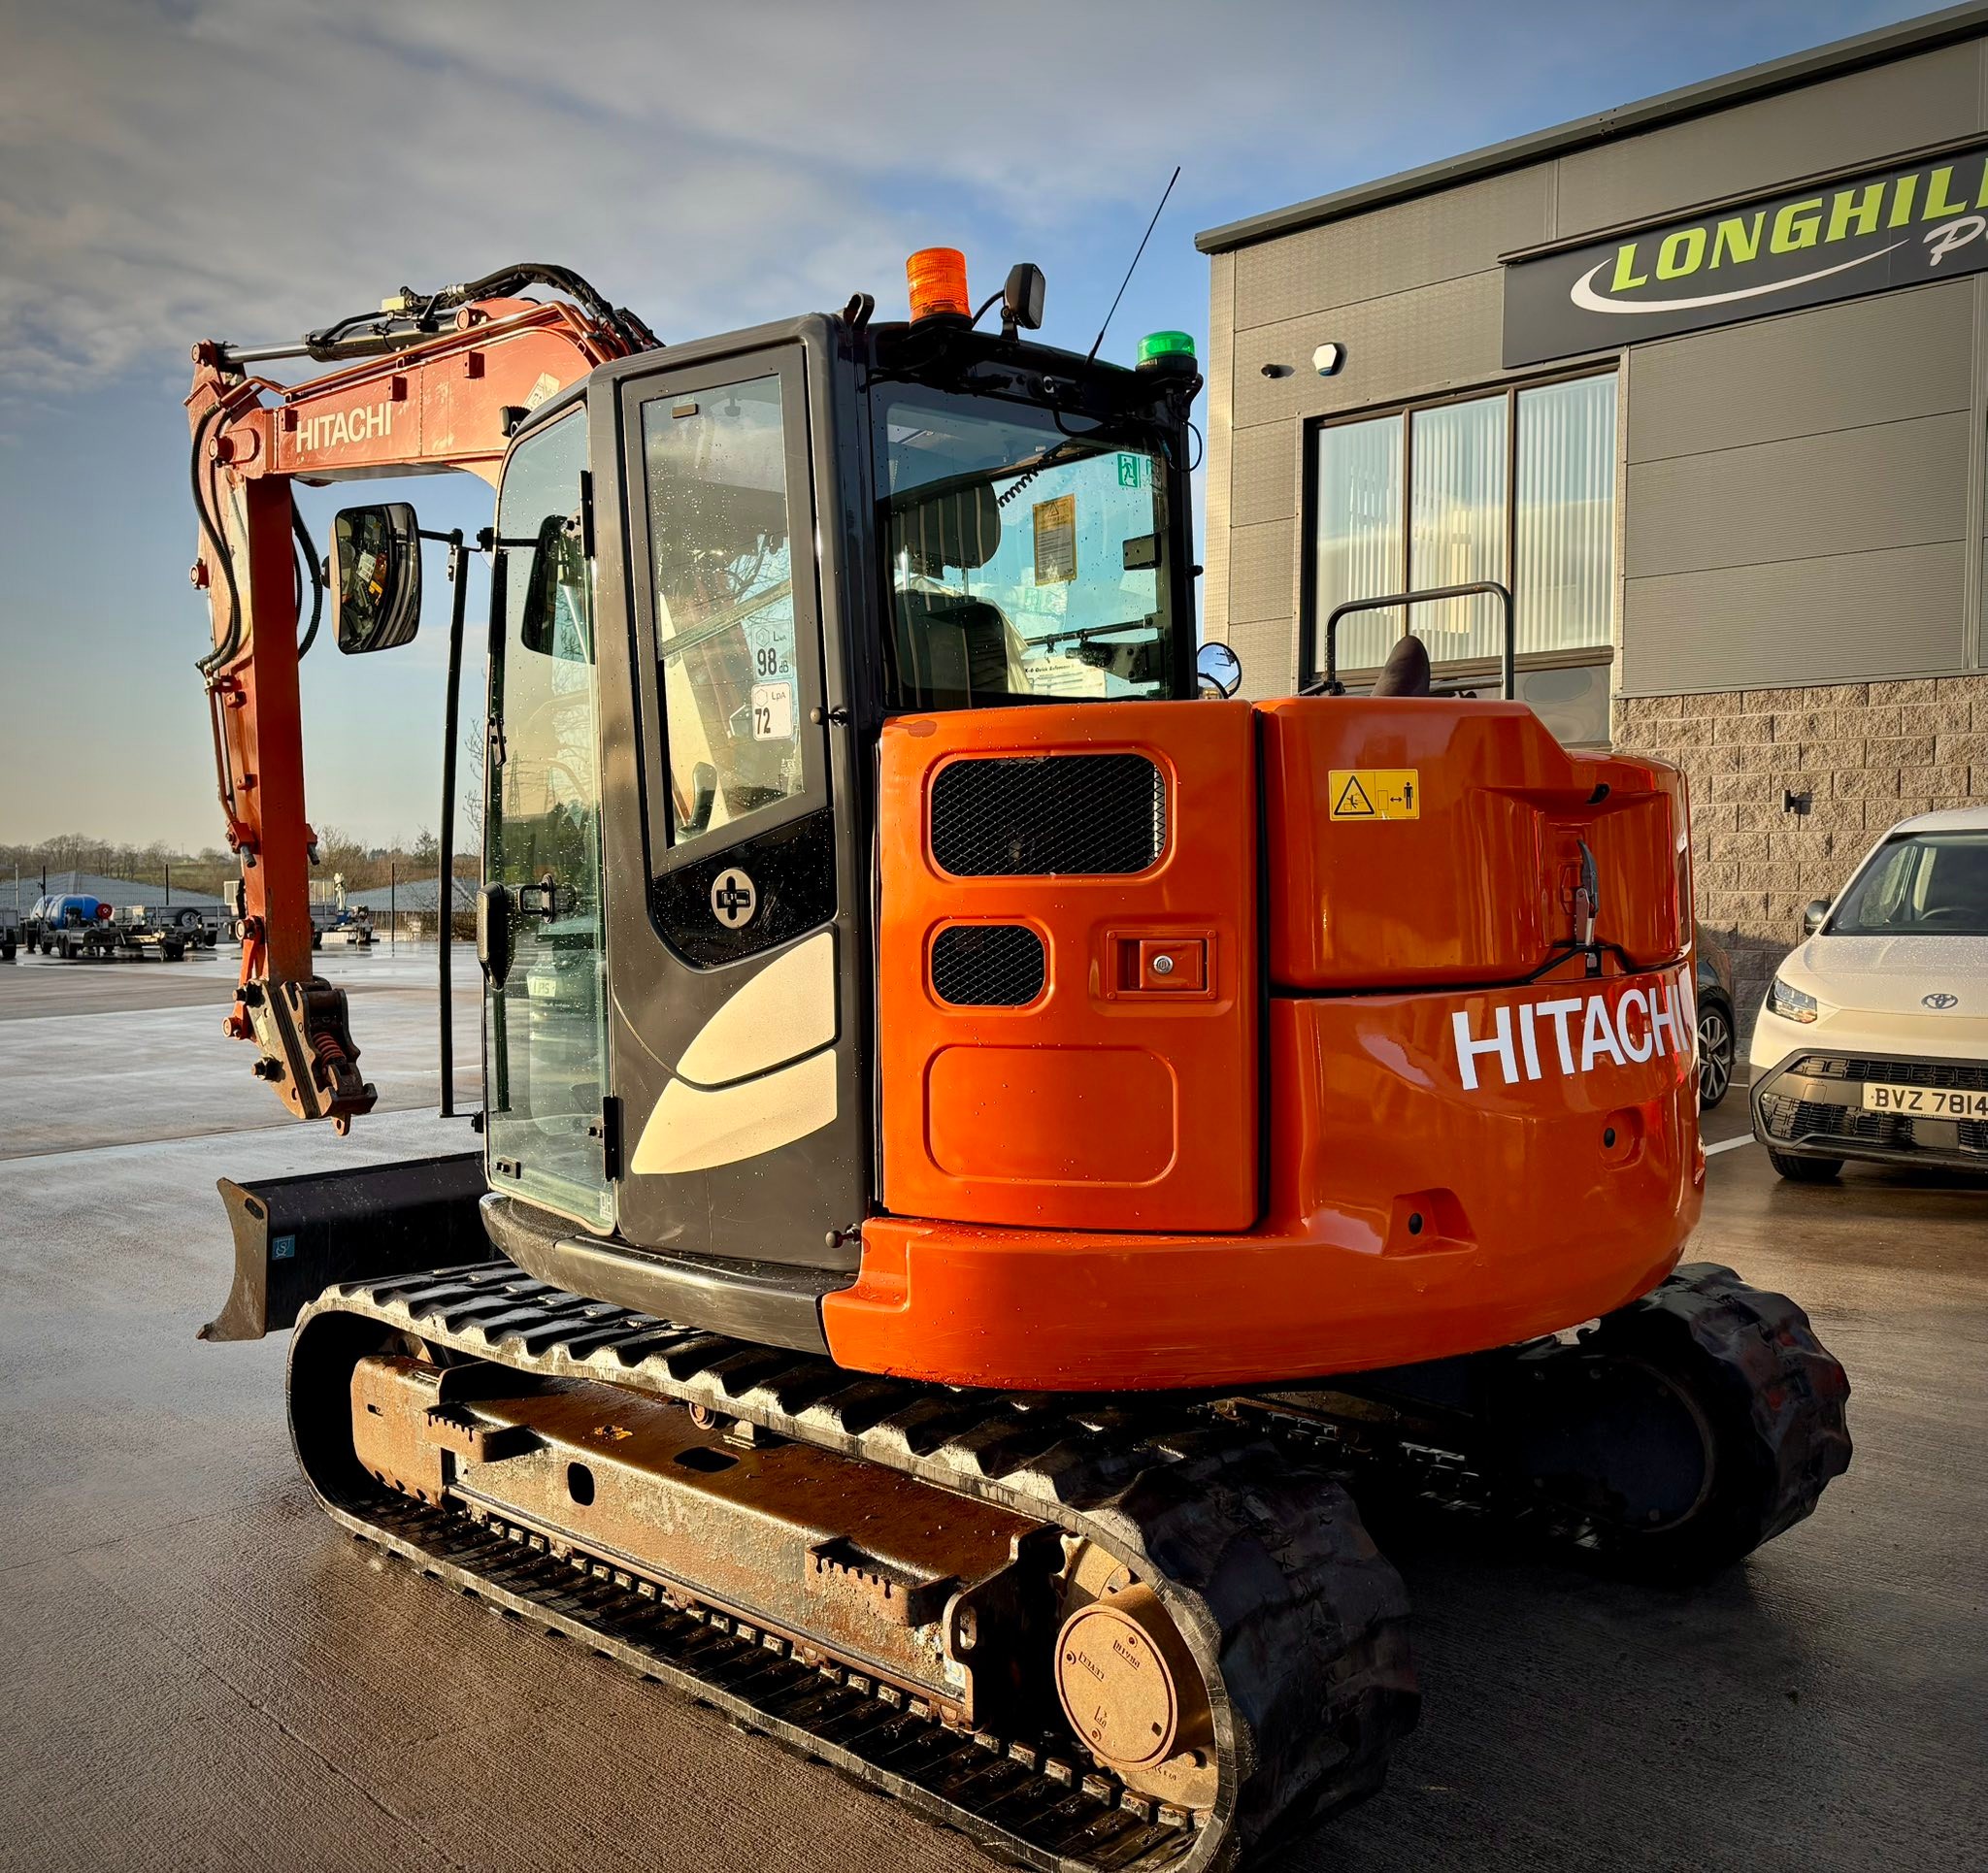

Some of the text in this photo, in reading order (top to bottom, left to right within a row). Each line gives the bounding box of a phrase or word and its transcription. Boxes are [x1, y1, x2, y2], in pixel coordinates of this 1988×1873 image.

[296, 400, 392, 453] HITACHI
[757, 647, 789, 676] 98 dB
[755, 706, 771, 735] 72
[1452, 984, 1689, 1090] HITACHI
[1875, 1087, 1988, 1116] BVZ 7814
